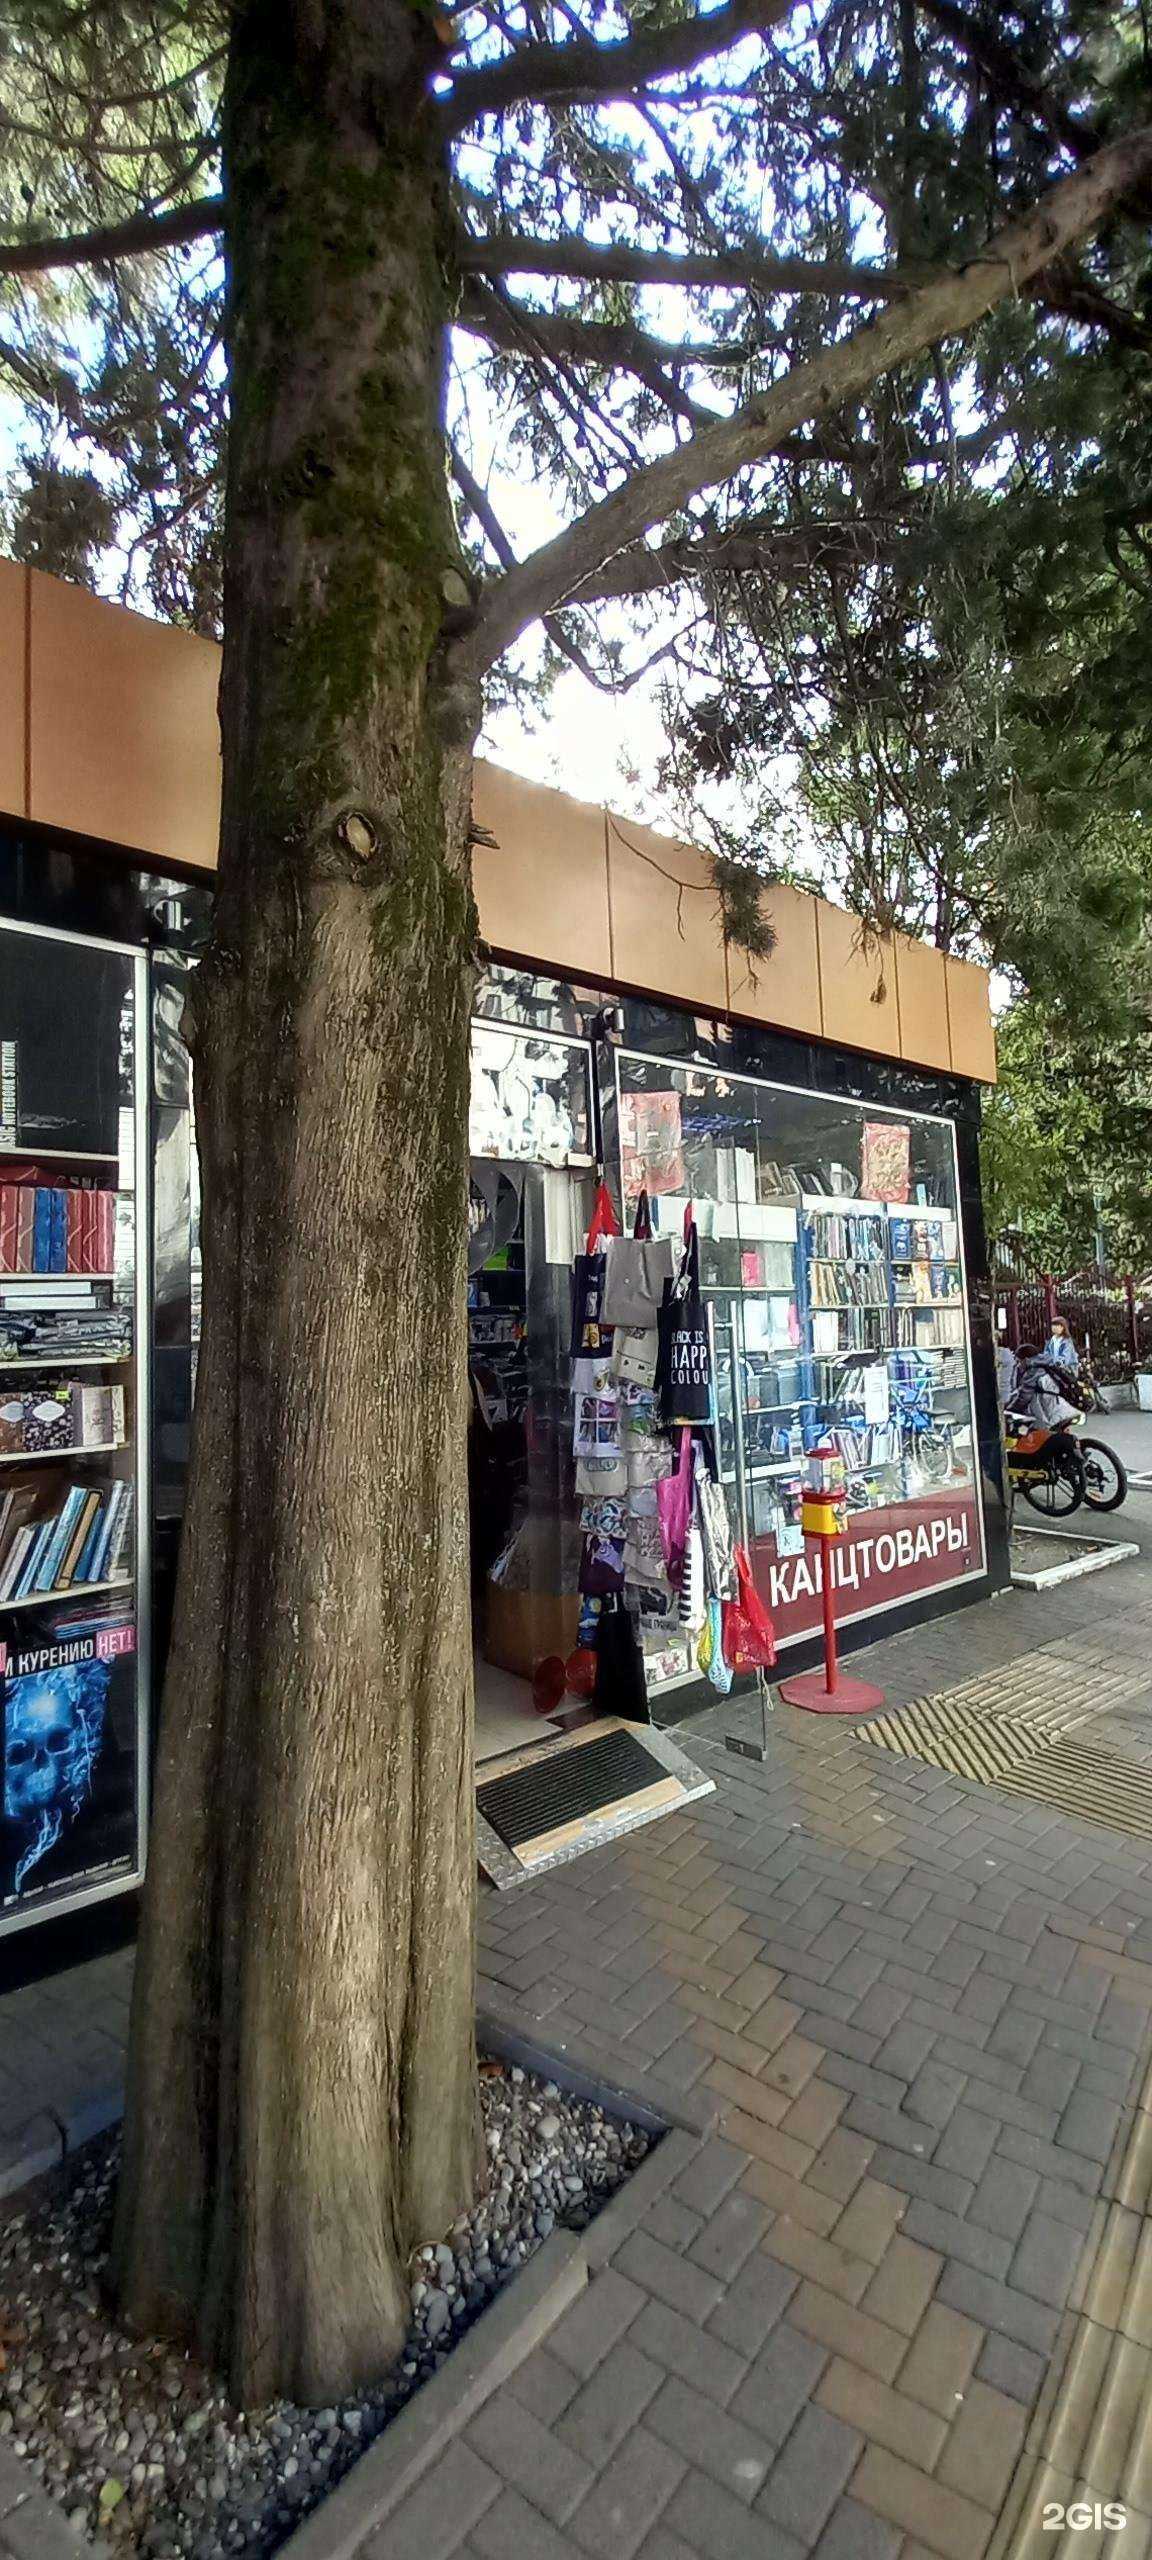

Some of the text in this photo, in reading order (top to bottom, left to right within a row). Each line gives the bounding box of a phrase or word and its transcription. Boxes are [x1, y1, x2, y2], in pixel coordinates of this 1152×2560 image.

[1, 1041, 16, 1077] STATION
[1, 1079, 16, 1124] NOTEBOOK
[695, 1330, 704, 1343] IS
[671, 1344, 708, 1369] HAPP
[671, 1369, 709, 1385] COLOU
[769, 1512, 968, 1607] КАНЦТОВАРЫ
[18, 1639, 94, 1675] КУРЕНИЮ
[98, 1629, 133, 1657] НЕТ!
